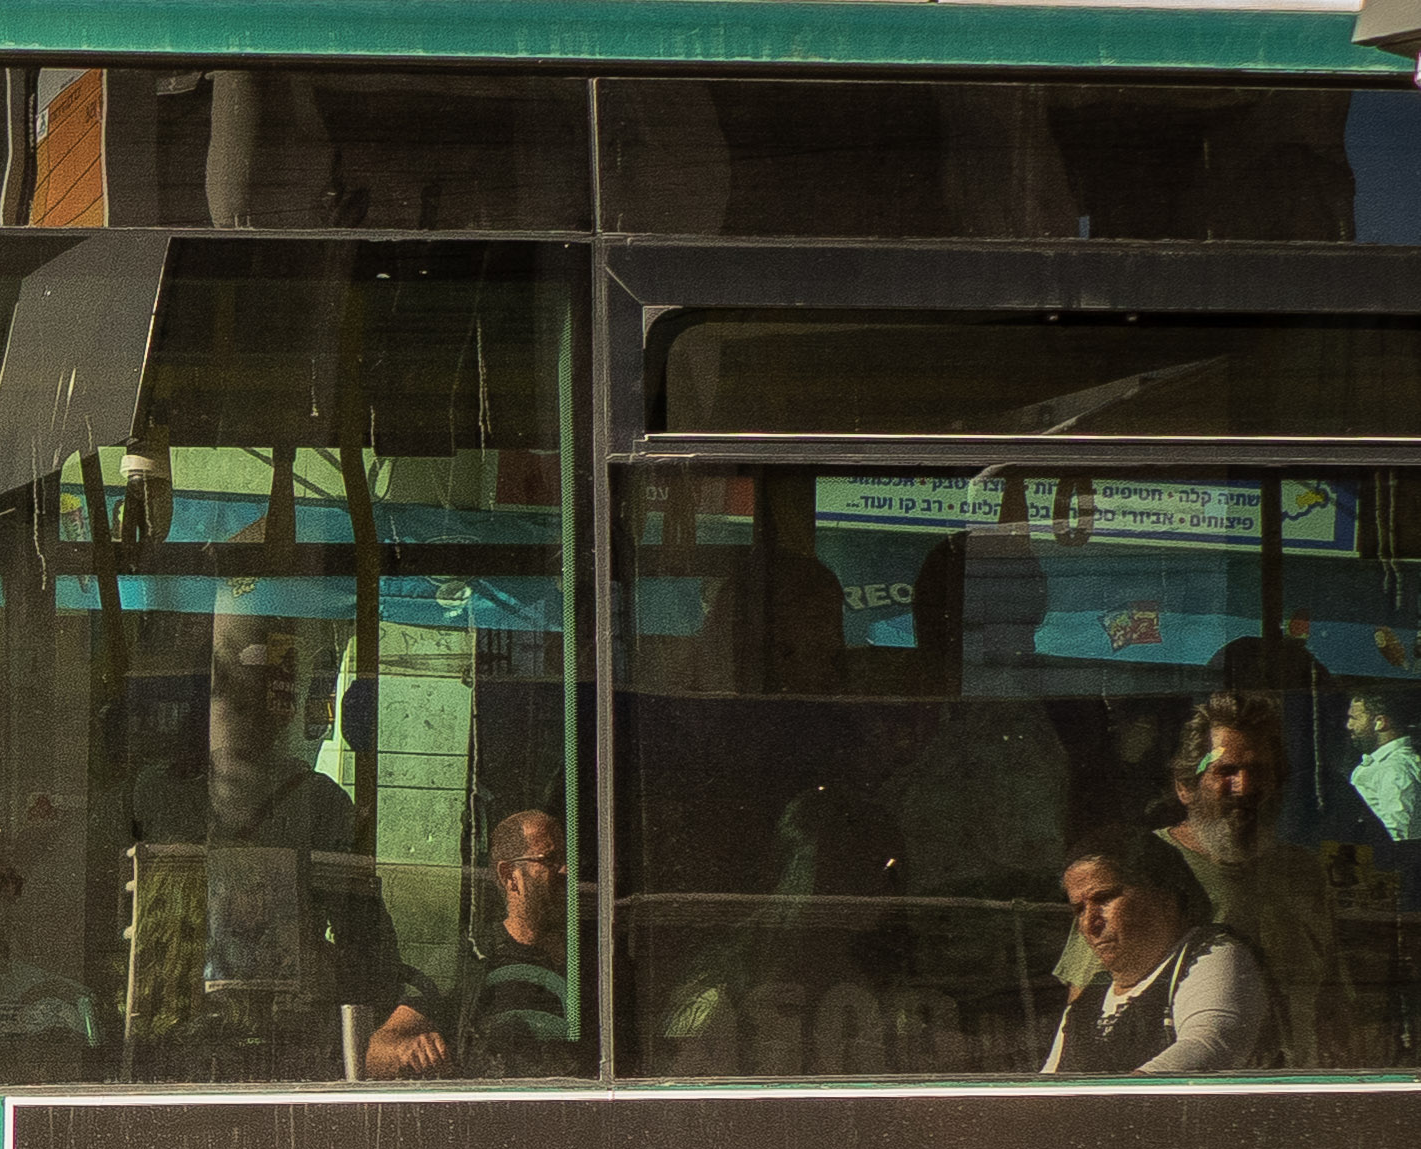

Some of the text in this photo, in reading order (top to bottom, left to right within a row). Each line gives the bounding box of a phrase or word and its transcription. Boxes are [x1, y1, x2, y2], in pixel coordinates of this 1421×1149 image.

[1103, 486, 1261, 507] שתיה קלה חטיפים
[899, 497, 916, 513] קו
[920, 500, 942, 512] רב
[1123, 510, 1174, 525] אביזרי
[1190, 515, 1253, 530] פיצוחים
